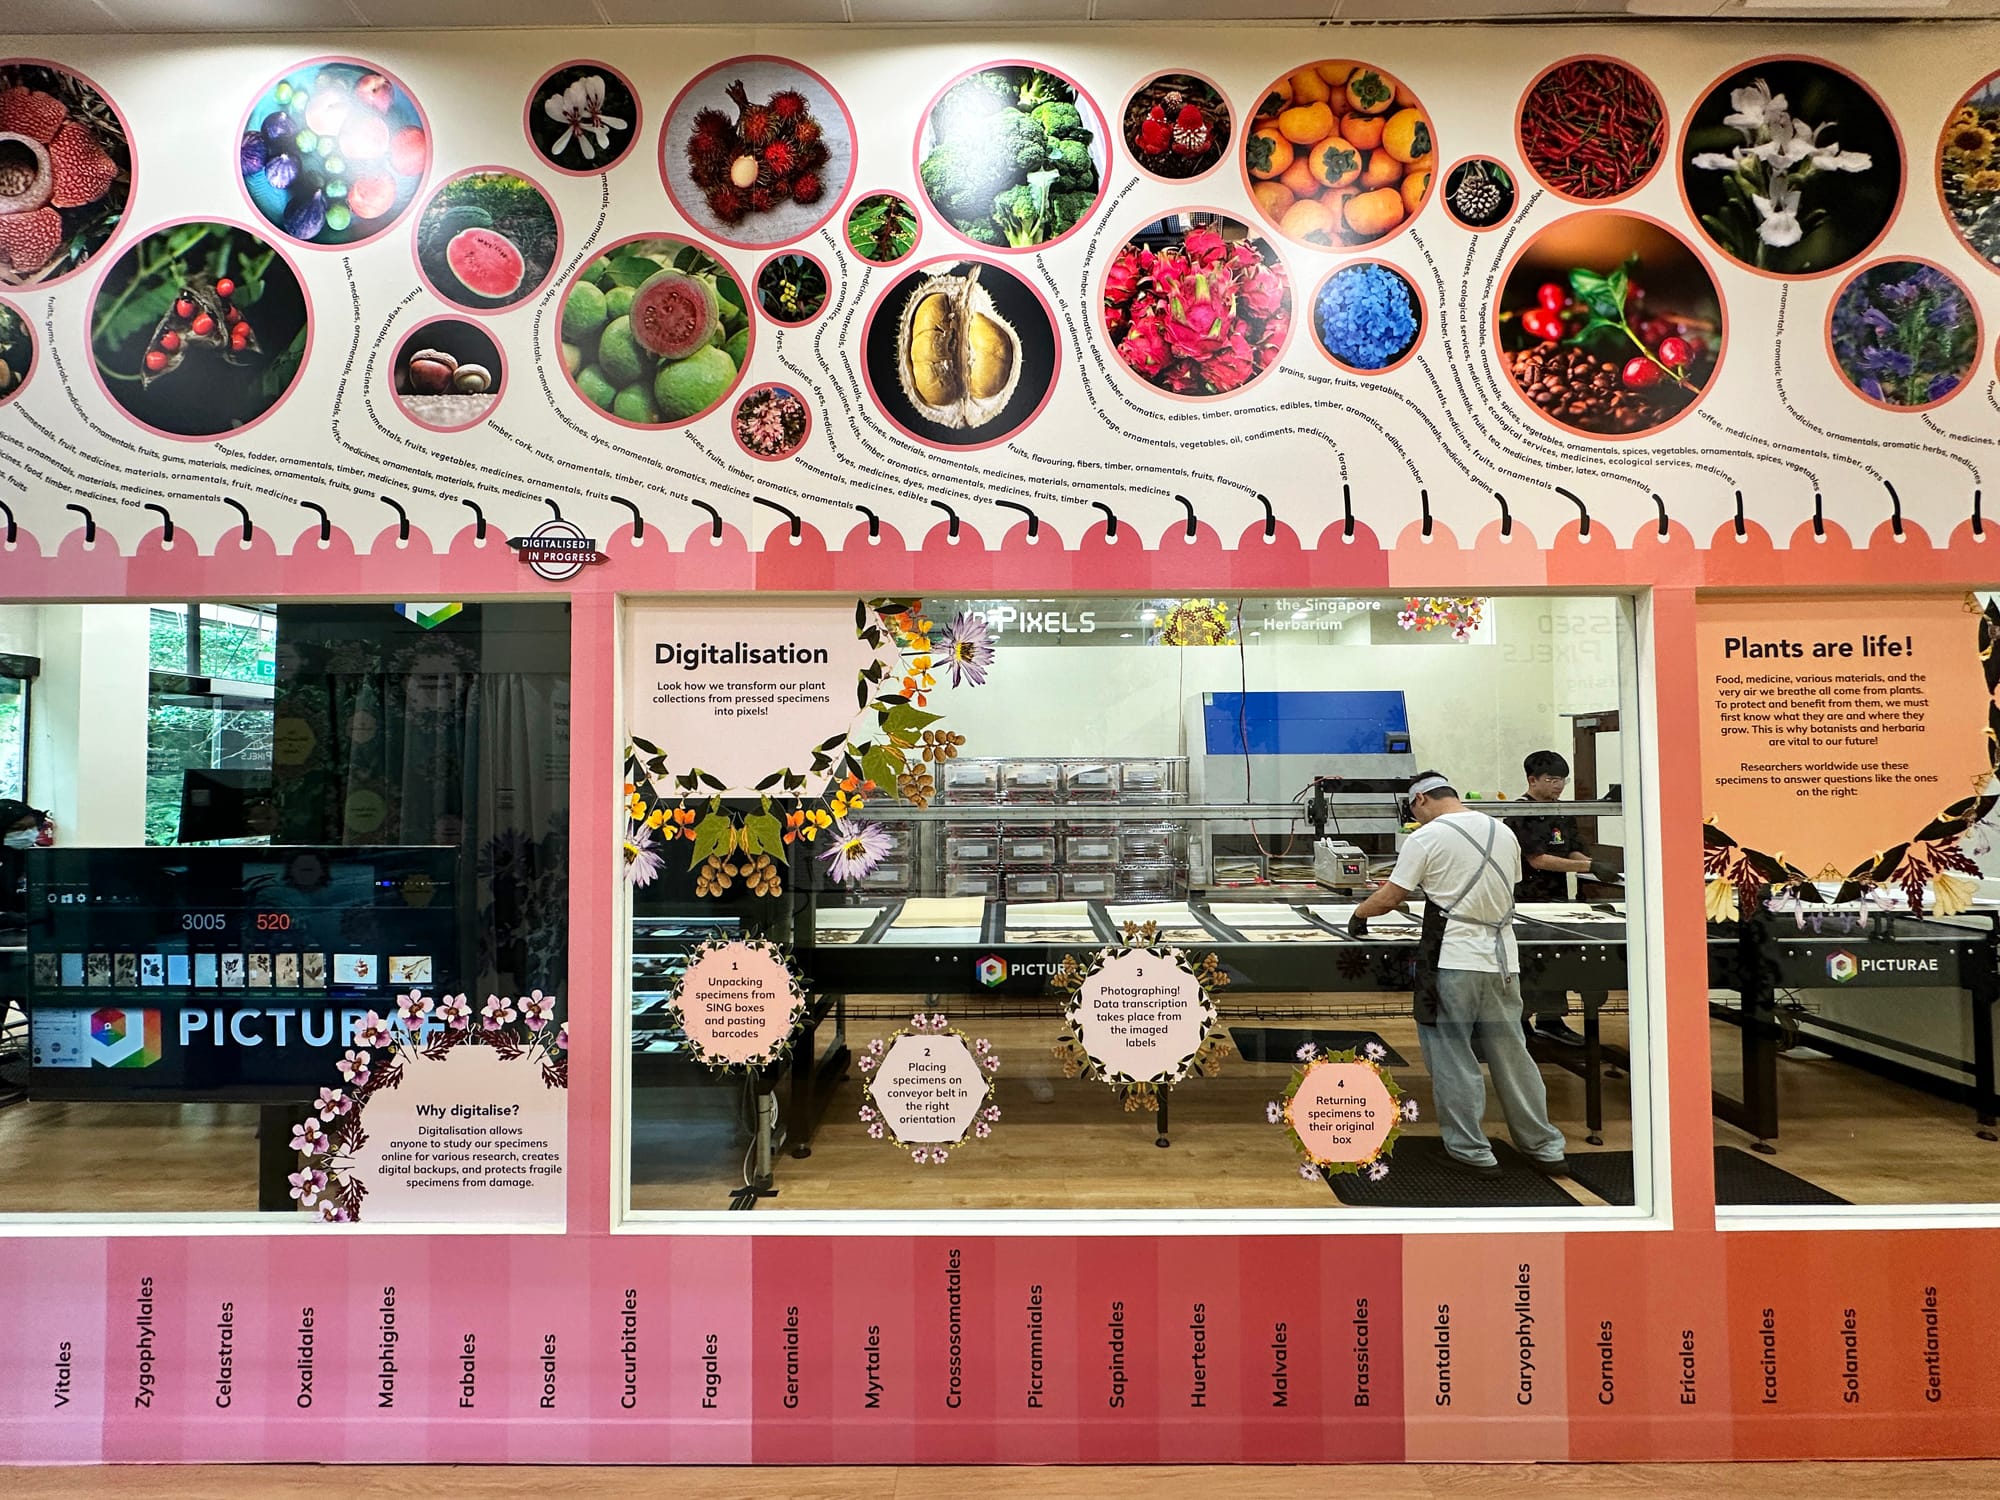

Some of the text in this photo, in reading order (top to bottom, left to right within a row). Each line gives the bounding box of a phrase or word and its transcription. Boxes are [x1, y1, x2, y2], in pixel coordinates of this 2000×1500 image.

[1697, 409, 1883, 482] coffee, medicines, ornamentals, timber, dyes
[214, 442, 459, 502] staples, fodder, ornamentals, timber, medicines, gums, dyes
[684, 429, 853, 509] spices, fruits, timber, aromatics, ornamentals
[1008, 443, 1257, 498] fruits, flavouring, fibers, timber, ornamentals, fruits, flavouring
[522, 539, 591, 549] DIGITALISED!
[528, 551, 597, 562] IN PROGRESS
[1275, 599, 1381, 613] the Singapore
[1264, 618, 1342, 630] Herbarium
[1725, 635, 1912, 658] Plants are life!
[656, 642, 827, 670] Digitalisation
[1716, 675, 1743, 684] Food,
[1746, 675, 1792, 683] medicine,
[1835, 674, 1885, 682] materials,
[1888, 673, 1906, 681] and
[1910, 673, 1926, 681] the
[658, 682, 681, 690] Look
[685, 682, 706, 690] how
[727, 681, 776, 690] transform
[800, 681, 825, 692] plant
[1719, 690, 1740, 698] very
[1744, 688, 1757, 696] air
[1777, 687, 1816, 695] breathe
[1819, 687, 1830, 695] all
[1863, 686, 1887, 694] from
[1890, 686, 1923, 696] plants.
[653, 694, 829, 704] collections from pressed specimens
[715, 707, 768, 717] into pixels!
[182, 913, 226, 930] 3005
[257, 913, 290, 930] 520
[733, 962, 738, 970] 1
[1861, 959, 1939, 971] PICTURAE
[709, 977, 762, 988] Unpacking
[696, 990, 775, 1001] specimens from
[1101, 986, 1179, 997] Photographing!
[707, 1003, 764, 1012] SING boxes
[1094, 999, 1187, 1009] Data transcription
[705, 1016, 765, 1027] and pasting
[1097, 1012, 1181, 1023] takes place from
[712, 1029, 759, 1039] barcodes
[1111, 1025, 1167, 1036] the imaged
[1126, 1038, 1155, 1047] labels
[924, 1048, 930, 1056] 2
[909, 1063, 946, 1073] Placing
[893, 1076, 946, 1086] specimens
[1338, 1080, 1344, 1088] 4
[888, 1089, 967, 1099] conveyor belt in
[906, 1102, 949, 1112] the right
[1317, 1096, 1366, 1106] Returning
[416, 1104, 519, 1119] Why digitalise?
[1308, 1109, 1361, 1120] specimens
[900, 1115, 955, 1123] orientation
[419, 1126, 522, 1137] Digitalisation allows
[1309, 1122, 1374, 1133] their original
[391, 1142, 427, 1150] anyone
[444, 1139, 472, 1149] study
[495, 1139, 548, 1149] specimens
[1333, 1135, 1351, 1144] box
[382, 1152, 412, 1160] online
[415, 1152, 429, 1160] for
[432, 1152, 469, 1160] various
[473, 1152, 518, 1161] research,
[379, 1165, 562, 1176] digital backups, and protects fragile
[407, 1178, 533, 1189] specimens from damage.
[945, 1250, 961, 1408] Crossosomatales
[1515, 1264, 1535, 1405] Caryophyllales
[136, 1277, 155, 1408] Zygophyllales
[379, 1287, 398, 1407] Malphigiales
[621, 1289, 636, 1408] Cucurbitales
[1027, 1286, 1042, 1407] Picramniales
[1921, 1287, 1941, 1402] Gentianales
[216, 1303, 233, 1408] Celastrales
[297, 1308, 313, 1408] Oxalidales
[783, 1307, 798, 1408] Geraniales
[1109, 1302, 1128, 1408] Sapindales
[1190, 1304, 1206, 1407] Huerteales
[1353, 1299, 1369, 1406] Brassicales
[1434, 1305, 1450, 1406] Santalales
[1759, 1309, 1777, 1403] Icacinales
[1841, 1309, 1859, 1403] Solanales
[864, 1326, 883, 1408] Myrtales
[1272, 1323, 1287, 1406] Malvales
[1597, 1321, 1614, 1404] Cornales
[1679, 1330, 1695, 1404] Ericales
[55, 1342, 71, 1408] Vitales
[460, 1334, 475, 1407] Fabales
[540, 1335, 555, 1408] Rosales
[702, 1335, 721, 1408] Fagales
